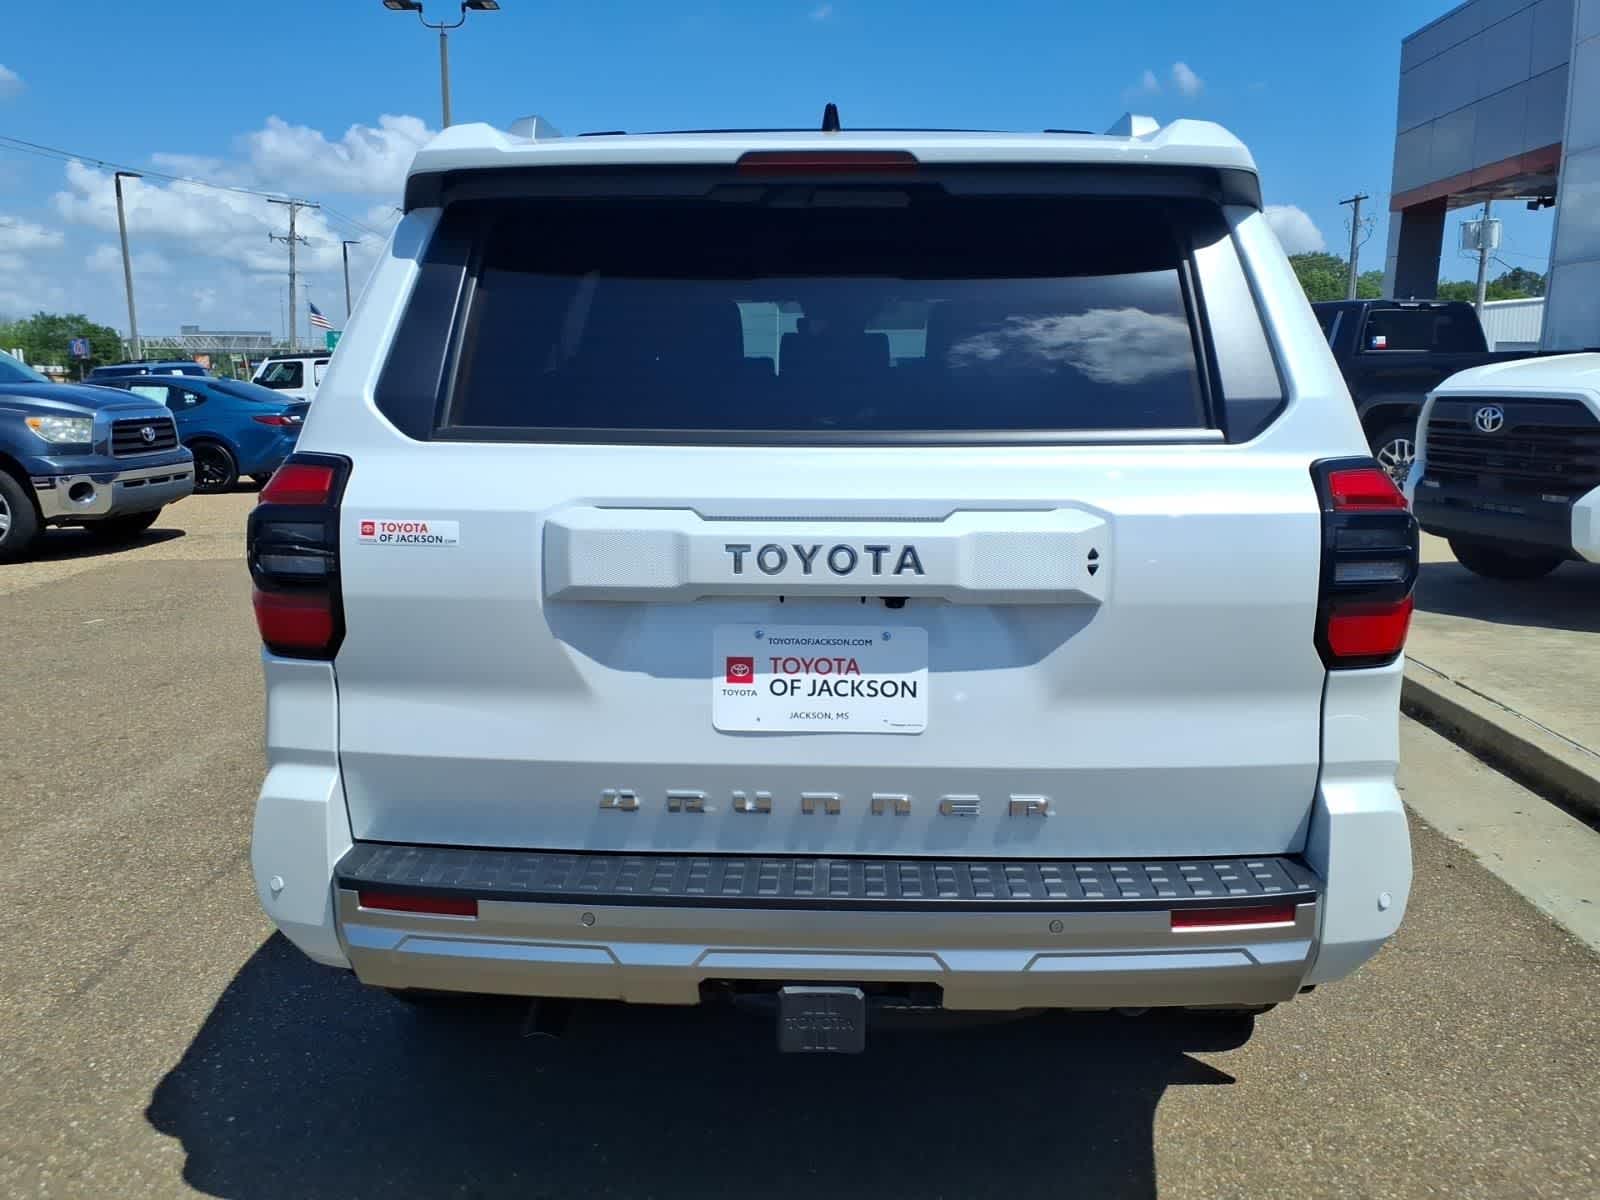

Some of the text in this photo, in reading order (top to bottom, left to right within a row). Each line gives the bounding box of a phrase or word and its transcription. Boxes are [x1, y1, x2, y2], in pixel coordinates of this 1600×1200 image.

[380, 522, 428, 533] TOYOTA
[379, 534, 393, 542] OF
[396, 534, 443, 543] JACKSON
[725, 543, 925, 576] TOYOTA
[768, 637, 873, 647] TOYOTAOFJACKSON.COM
[769, 656, 861, 676] TOYOTA
[722, 688, 758, 697] TOYOTA
[769, 678, 918, 698] OF JACKSON
[836, 711, 849, 720] MS
